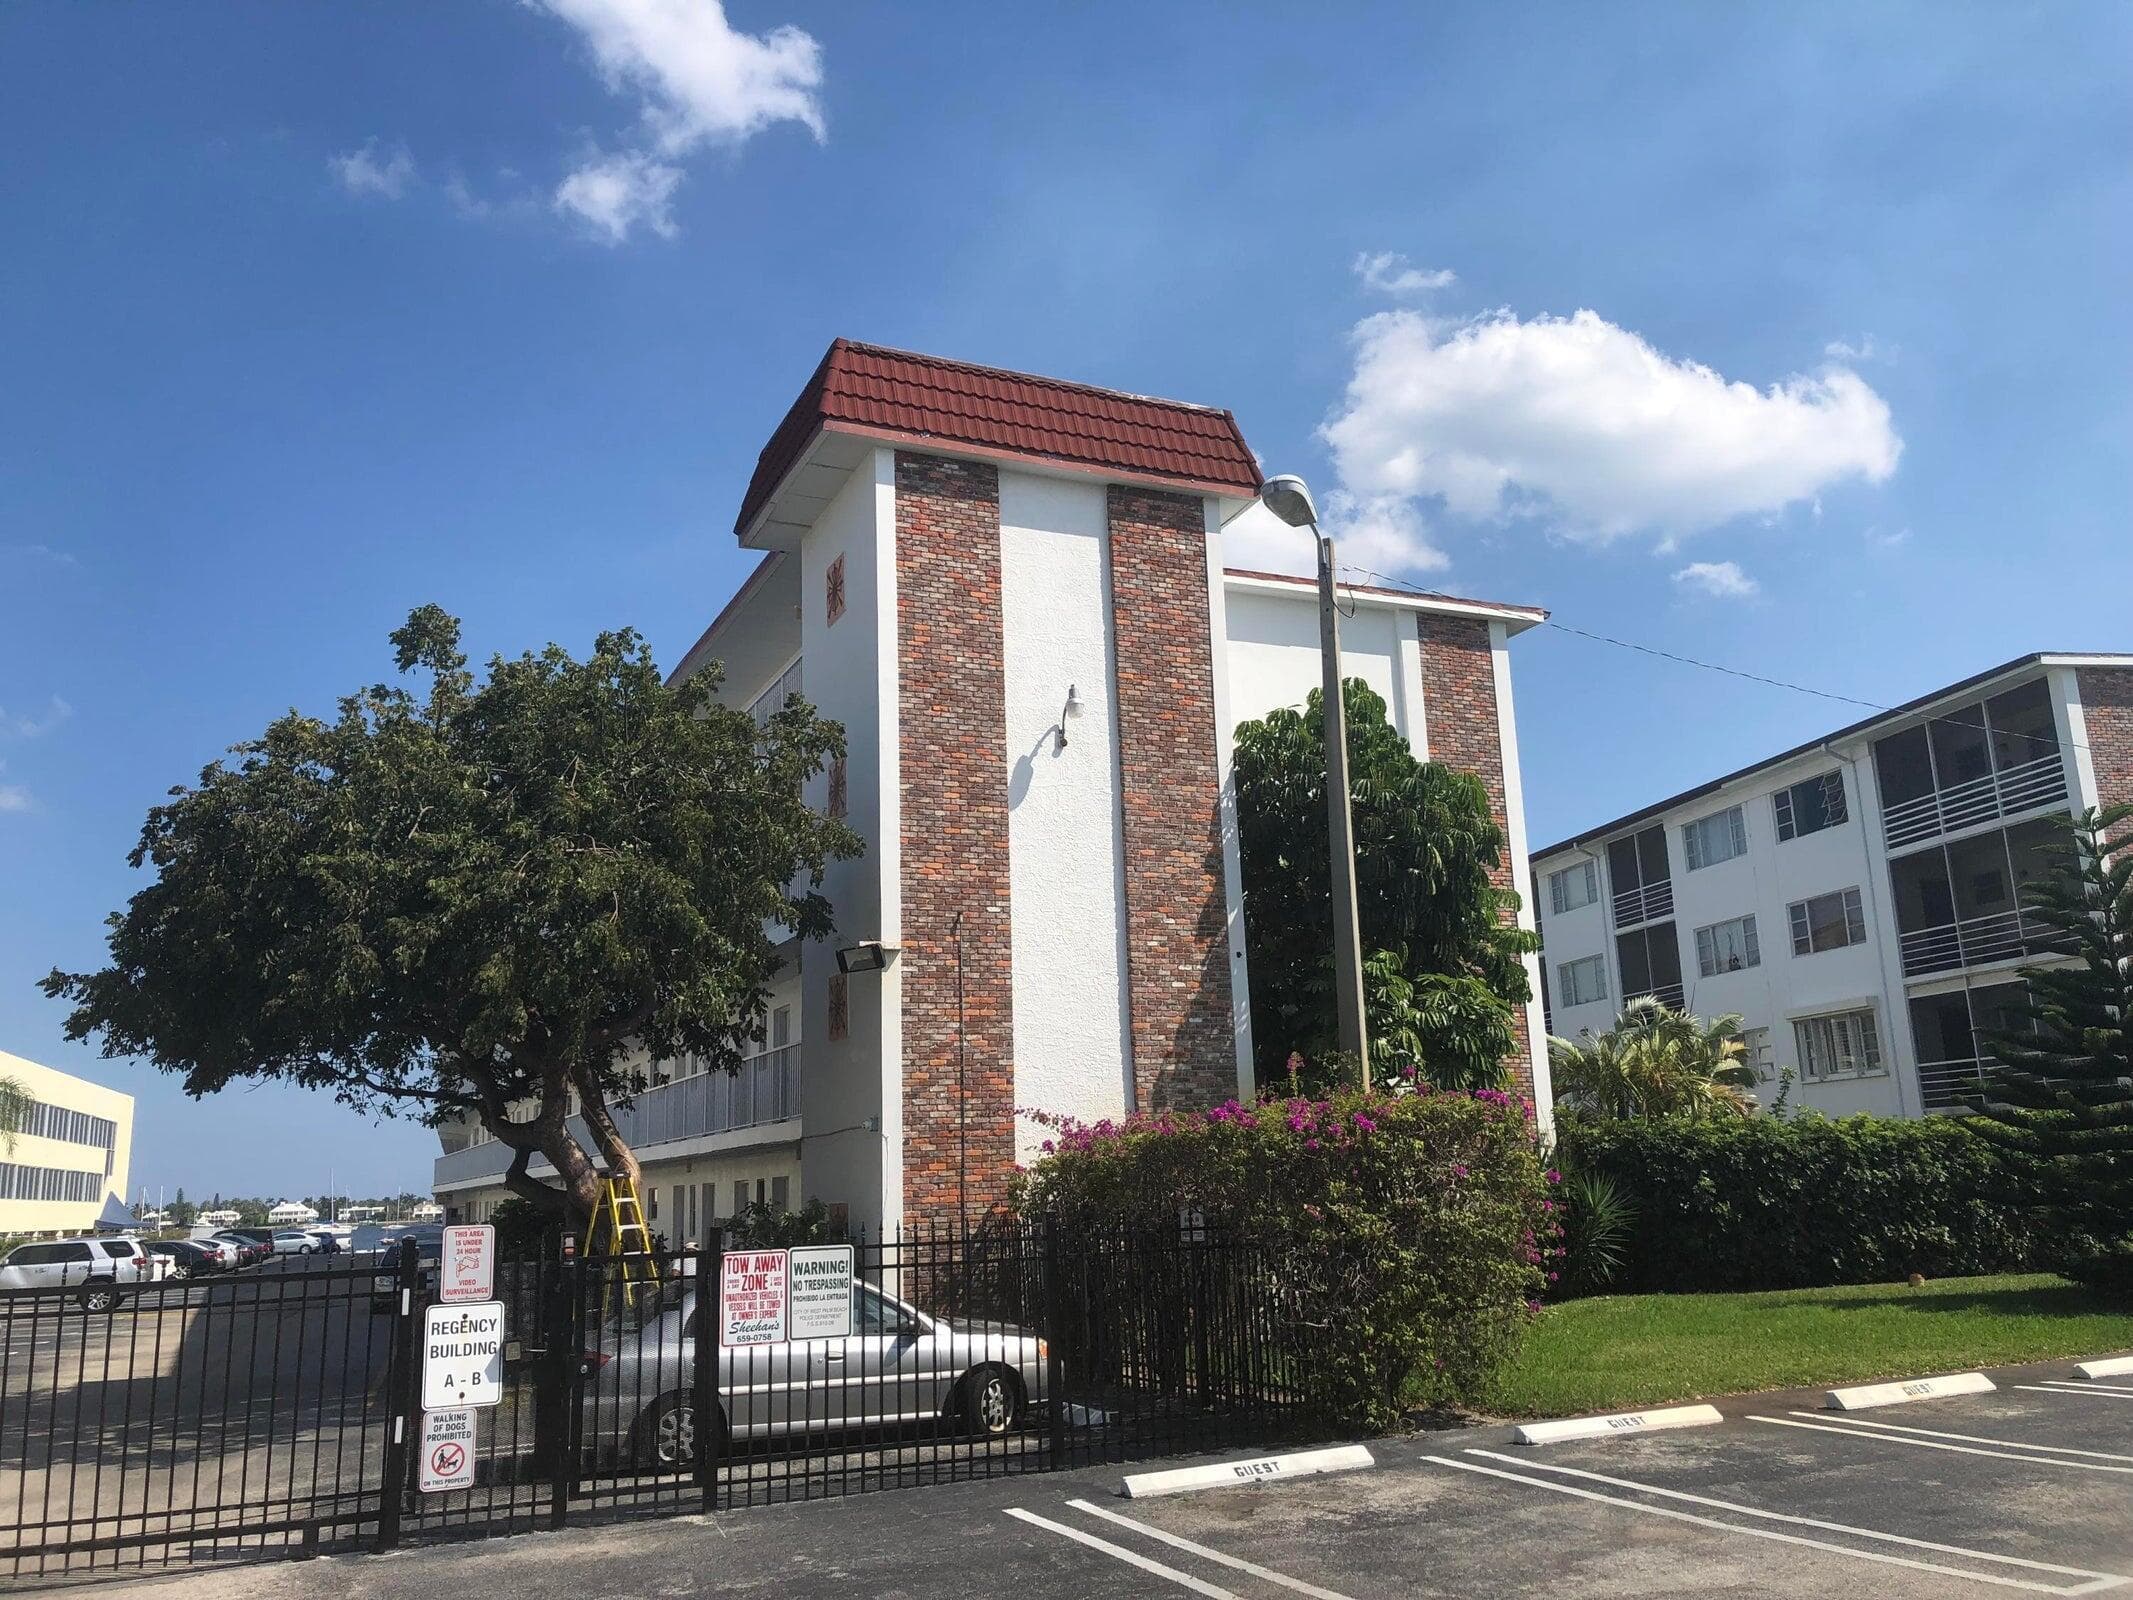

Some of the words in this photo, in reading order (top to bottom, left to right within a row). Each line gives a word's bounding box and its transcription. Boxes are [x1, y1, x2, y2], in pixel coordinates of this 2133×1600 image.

[726, 1257, 750, 1275] TOW
[754, 1255, 784, 1273] AWAY
[793, 1260, 849, 1276] WARNING!
[741, 1273, 769, 1291] ZONE
[793, 1280, 803, 1292] NO
[804, 1277, 849, 1291] TRESPASSING
[445, 1286, 489, 1296] SURVEILLANCE
[725, 1292, 758, 1302] UNAUTHORIZED
[759, 1291, 778, 1301] VEHICLES
[793, 1294, 818, 1302] PROHIBIDO
[819, 1294, 826, 1302] LA
[826, 1293, 848, 1301] ENTRADA
[728, 1302, 746, 1312] VESSELS
[748, 1301, 757, 1310] WILL
[766, 1300, 781, 1310] TOWED
[431, 1318, 498, 1336] REGENCY
[728, 1319, 780, 1335] Sheehan's
[736, 1333, 772, 1343] 659-0758
[430, 1340, 497, 1359] BUILDING
[444, 1374, 454, 1388] A
[472, 1371, 481, 1386] B
[1902, 1383, 1936, 1397] GUEST
[433, 1412, 467, 1423] WALKING
[1607, 1416, 1647, 1429] GUEST
[433, 1424, 443, 1433] OF
[445, 1423, 466, 1432] DOGS
[426, 1431, 472, 1442] PROHIBITED
[1233, 1461, 1281, 1477] GUEST
[444, 1477, 470, 1485] PROPERTY
